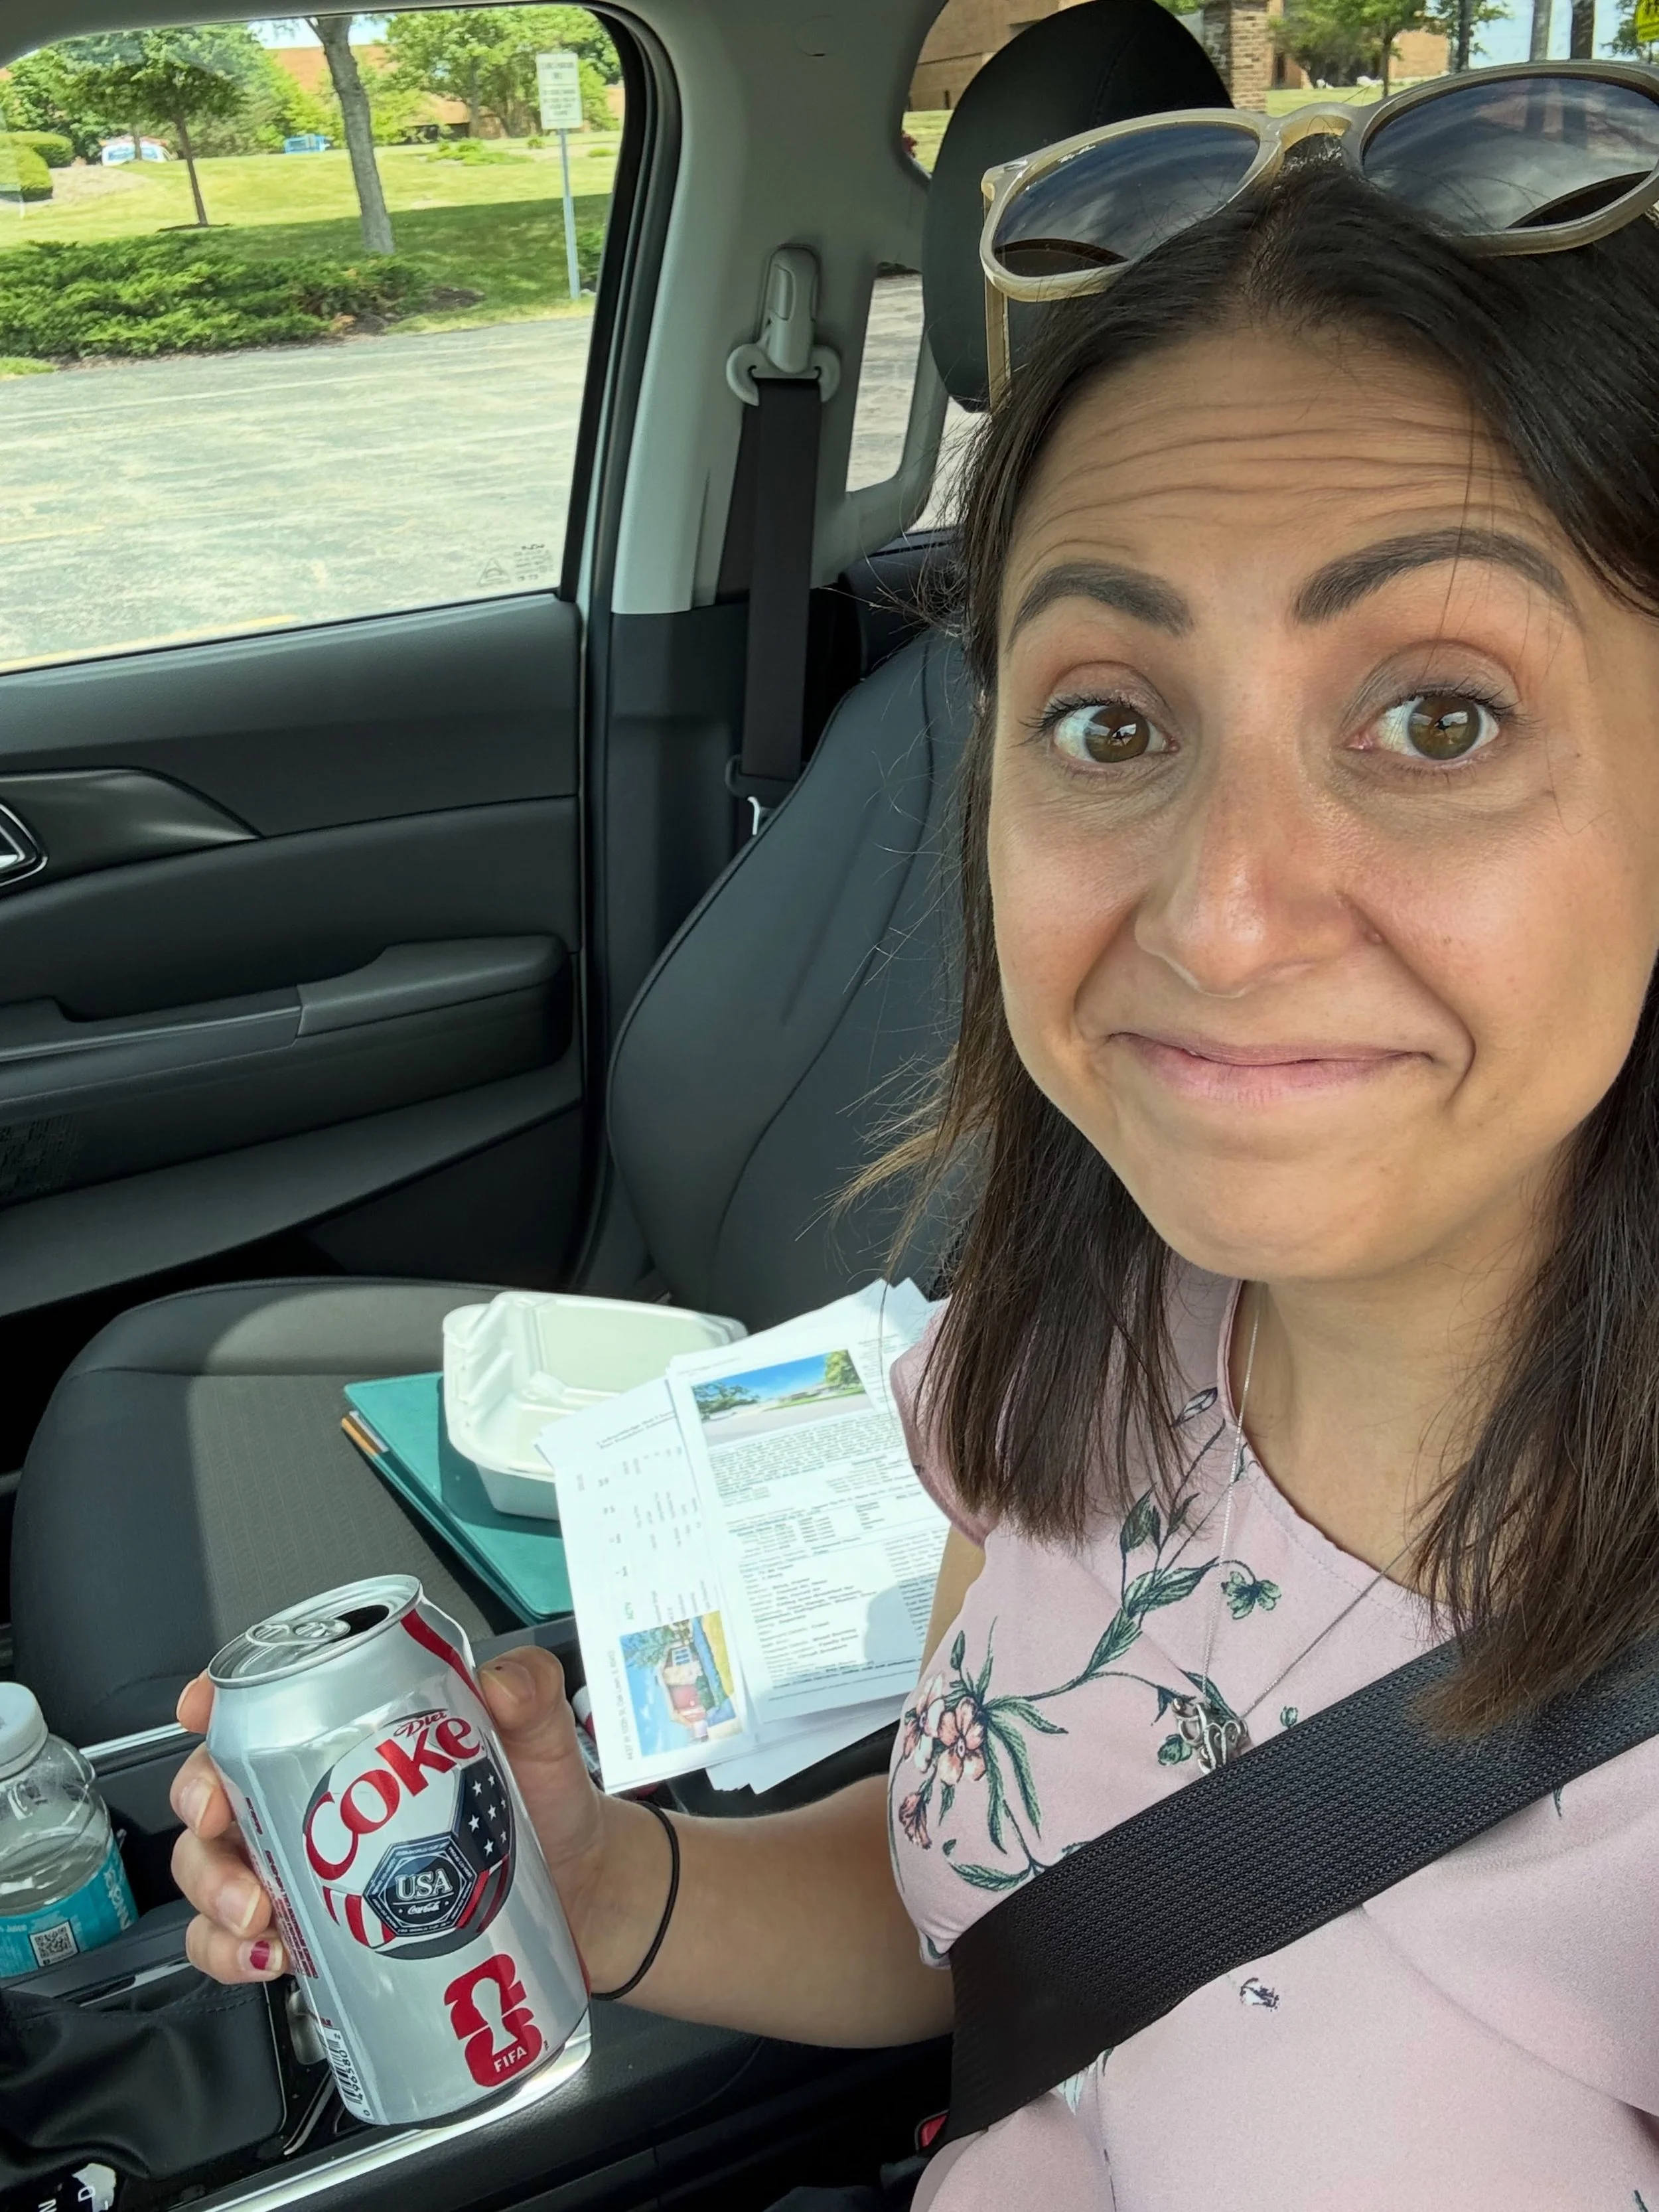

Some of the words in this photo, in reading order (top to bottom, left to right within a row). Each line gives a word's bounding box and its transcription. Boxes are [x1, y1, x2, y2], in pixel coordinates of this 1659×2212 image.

[393, 1712, 447, 1738] Diet
[306, 1718, 480, 1881] Coke
[395, 1868, 454, 1901] USA
[493, 2045, 528, 2073] FIFA
